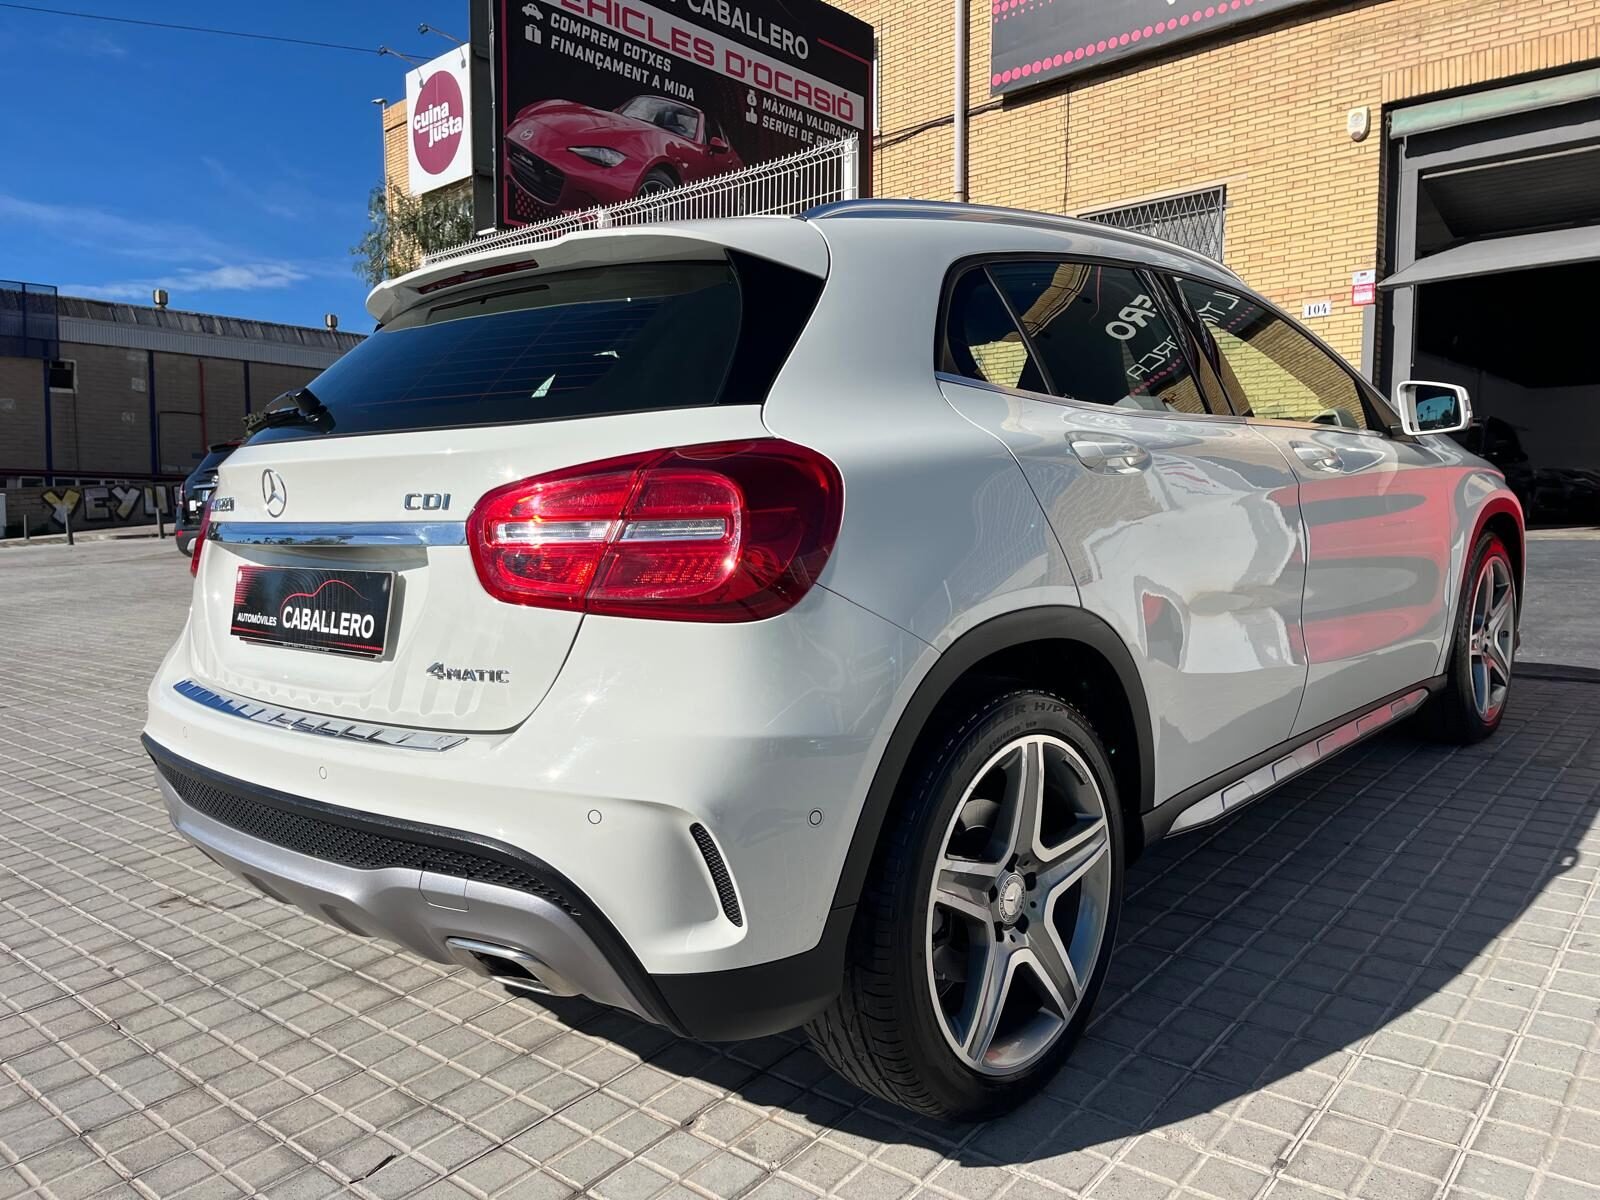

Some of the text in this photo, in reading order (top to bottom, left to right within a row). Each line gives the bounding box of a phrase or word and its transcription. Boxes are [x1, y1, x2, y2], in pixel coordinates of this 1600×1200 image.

[550, 12, 672, 73] COMPREM COTXES
[551, 35, 695, 101] FINANÇAMENT A MIDA
[725, 48, 853, 122] D'OCASIÓ
[414, 101, 450, 131] cuina
[428, 115, 463, 148] justa
[762, 115, 798, 139] SERVEI
[801, 129, 814, 144] DE
[1308, 303, 1327, 316] 104
[404, 493, 451, 511] CDI
[237, 606, 375, 639] AUTOMÓVILES CABALLERO
[426, 661, 510, 684] 4MATIC
